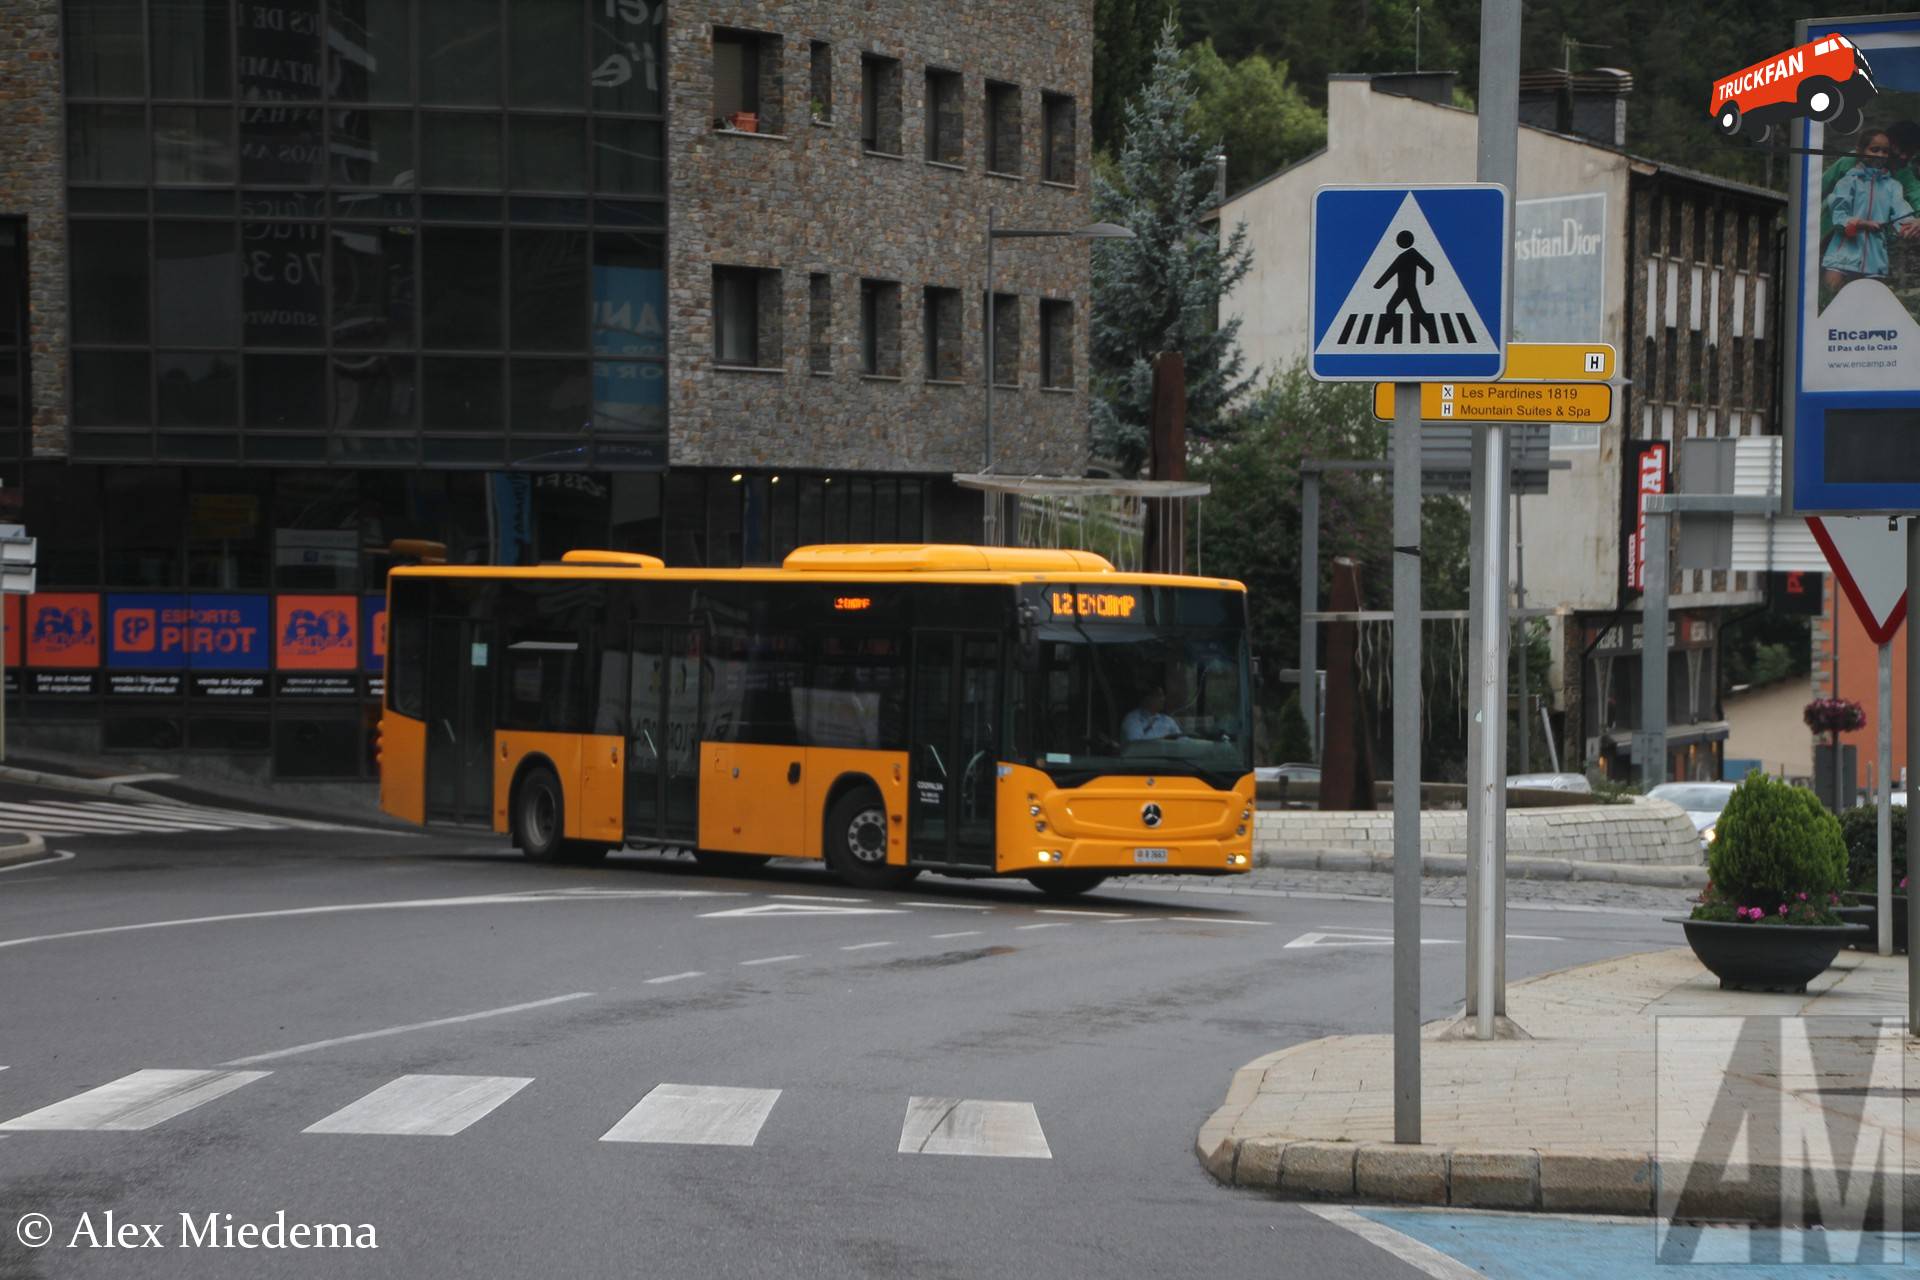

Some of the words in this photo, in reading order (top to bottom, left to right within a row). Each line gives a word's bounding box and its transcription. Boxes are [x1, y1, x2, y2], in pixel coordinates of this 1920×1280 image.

[1515, 217, 1601, 261] istianDior
[1828, 328, 1898, 341] Encamp
[1828, 344, 1836, 352] El
[1837, 344, 1852, 352] Pas
[1854, 344, 1866, 352] de
[1877, 343, 1898, 351] Casa
[1590, 355, 1599, 369] H
[1827, 359, 1898, 369] www.encamp.ad
[1461, 387, 1484, 399] Les
[1487, 388, 1543, 400] Pardines
[1547, 388, 1578, 400] 1819
[1460, 404, 1514, 416] Mountain
[1516, 406, 1552, 417] Suites
[1555, 406, 1565, 417] &
[1567, 406, 1592, 420] Spa
[162, 609, 241, 624] ESPORTS
[161, 627, 257, 653] PIROT
